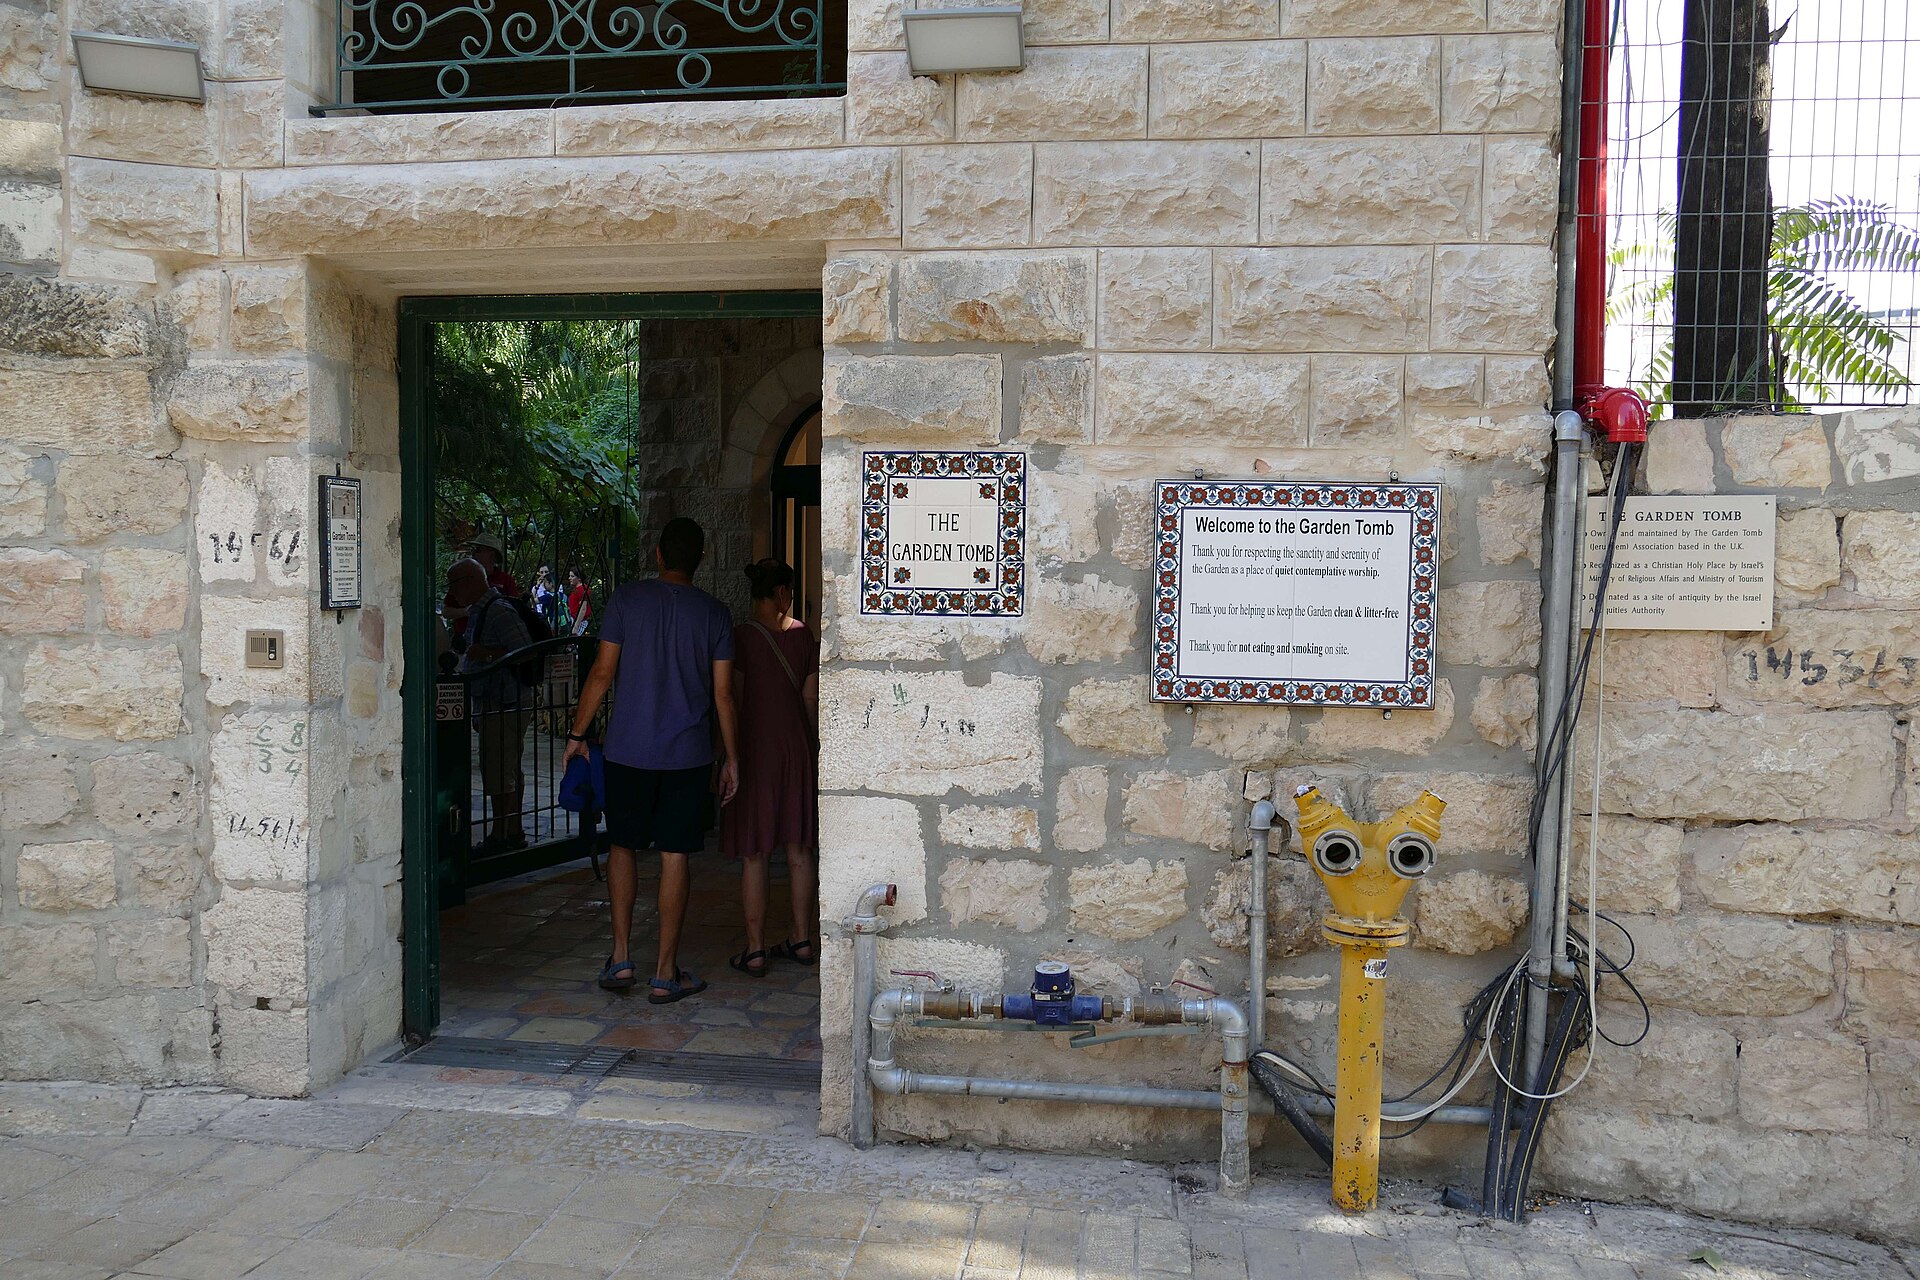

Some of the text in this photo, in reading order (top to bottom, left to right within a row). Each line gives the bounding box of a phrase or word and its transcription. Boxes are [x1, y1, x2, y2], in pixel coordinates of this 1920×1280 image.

[928, 513, 959, 531] THE
[1599, 511, 1742, 522] TE GARDEN TOMB
[1195, 516, 1394, 535] Welcome to the Garden Tomb
[1682, 529, 1690, 538] by
[892, 544, 995, 562] GARDEN TOMB
[1192, 544, 1381, 563] Thank you for respecting the sanctity and serenity of
[1192, 564, 1202, 574] the
[1205, 564, 1230, 574] Garden
[1246, 565, 1264, 577] place
[1266, 565, 1274, 575] of
[1275, 565, 1293, 577] quiet
[1296, 566, 1346, 578] contemplative
[1347, 567, 1380, 579] worship.
[1687, 562, 1703, 570] Holy
[1730, 562, 1737, 570] by
[1628, 575, 1656, 583] Religious
[1699, 575, 1724, 584] Ministry
[1679, 594, 1710, 602] antiquity
[1714, 594, 1723, 602] by
[1190, 603, 1399, 619] Thank you for helping us keep the Garden clean & litter-free
[1632, 607, 1665, 615] Authority
[1189, 640, 1210, 652] Thank
[1212, 644, 1225, 654] you
[1227, 640, 1237, 652] for
[1239, 643, 1250, 652] not
[1253, 642, 1274, 656] eating
[1276, 642, 1290, 653] and
[1292, 643, 1323, 657] smoking
[1335, 643, 1349, 655] site.
